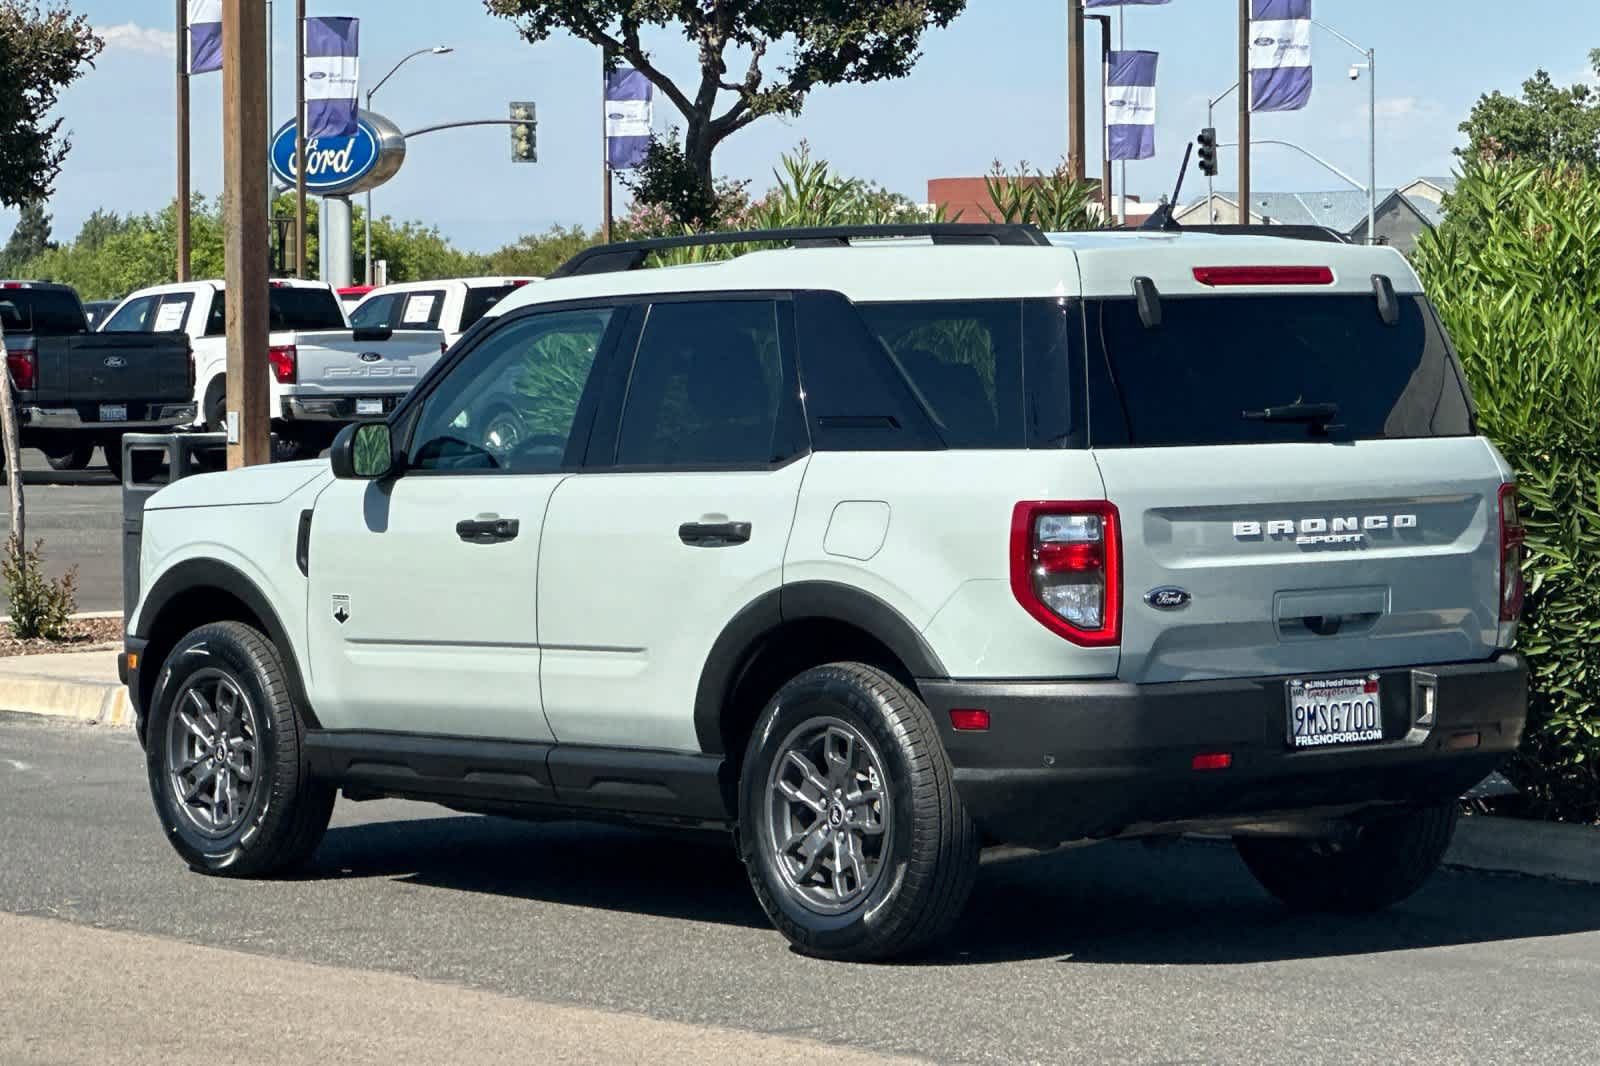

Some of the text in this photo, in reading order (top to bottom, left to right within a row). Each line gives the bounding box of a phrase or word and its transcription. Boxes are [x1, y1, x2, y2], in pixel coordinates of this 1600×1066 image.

[323, 365, 417, 378] F-150
[1233, 514, 1417, 536] BRONCO
[1296, 533, 1364, 545] SPORT
[1295, 700, 1376, 736] 9MSG700
[1295, 730, 1383, 746] FRESNOFORD.COM
